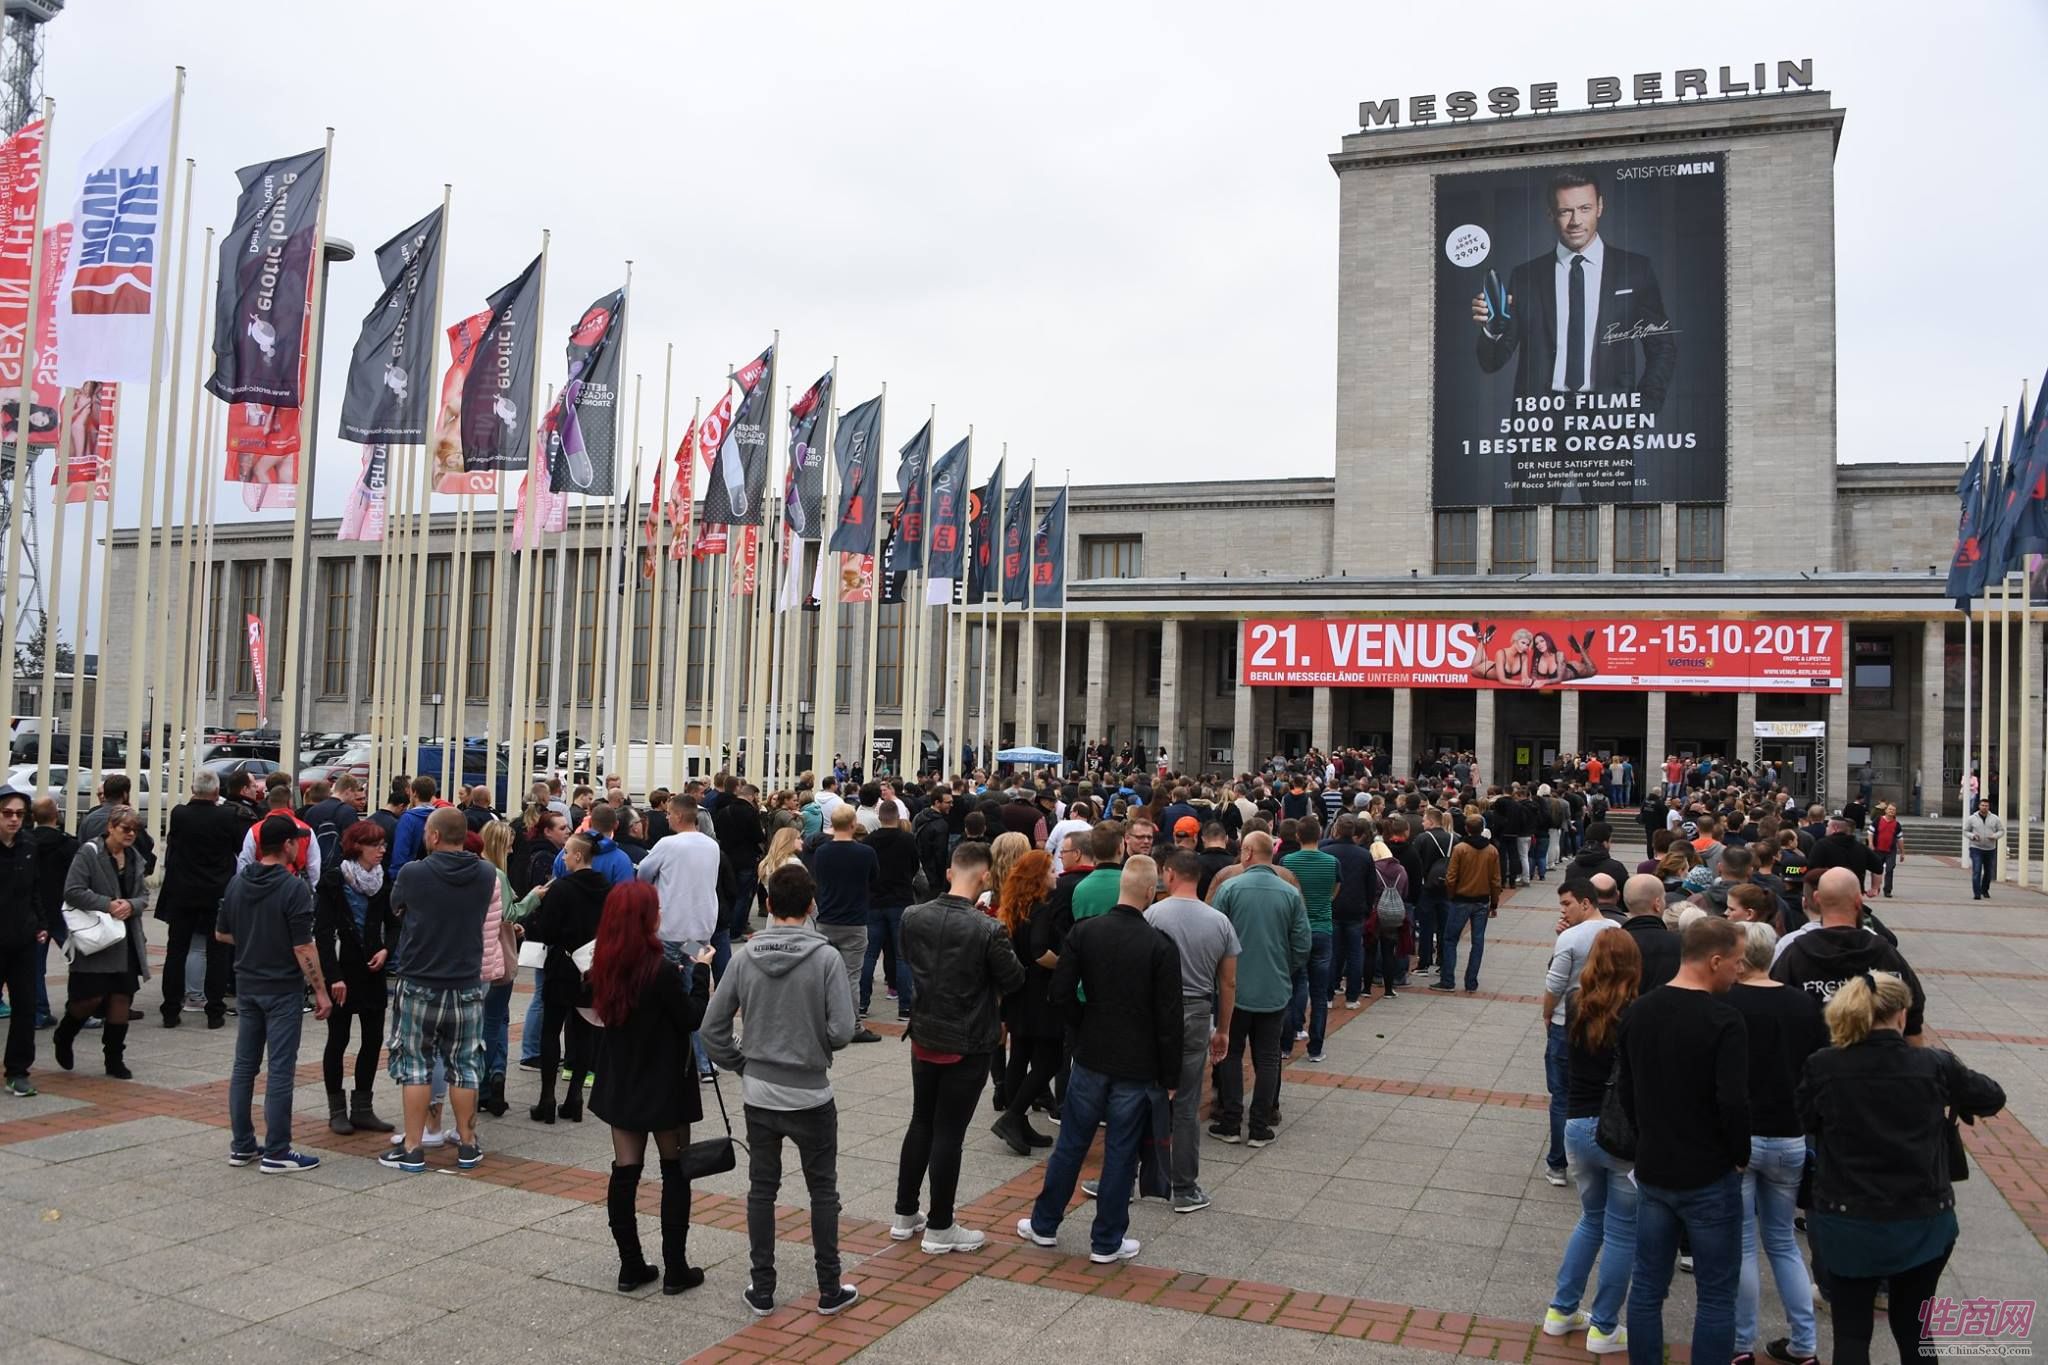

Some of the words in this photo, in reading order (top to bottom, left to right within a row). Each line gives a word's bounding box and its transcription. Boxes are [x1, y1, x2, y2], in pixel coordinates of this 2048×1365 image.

[1358, 82, 1558, 126] MESSE
[1587, 58, 1813, 105] BERLIN
[1616, 161, 1715, 180] SATISFYERMEN
[1515, 396, 1565, 412] 1800
[1575, 392, 1642, 410] FILME
[1500, 416, 1554, 433] 5000
[1564, 413, 1655, 431] FRAUEN
[1462, 440, 1470, 454] 1
[1479, 437, 1557, 454] BESTER
[1565, 432, 1697, 452] ORGASMUS
[1517, 461, 1535, 470] DER
[1537, 461, 1562, 469] NEUE
[1564, 459, 1610, 469] SATISFYER
[1527, 471, 1546, 479] Jetzt
[1548, 470, 1584, 479] bestellen
[1592, 479, 1615, 487] Stand
[1250, 624, 1311, 667] 21.
[1327, 624, 1477, 668] VENUS
[1602, 624, 1833, 655] 12.-15.10.2017
[1668, 656, 1707, 668] venus
[1250, 671, 1285, 682] BERLIN
[1287, 670, 1365, 682] MESSEGELÄNDE
[1367, 672, 1409, 683] UNTERM
[1412, 673, 1468, 684] FUNKTURM
